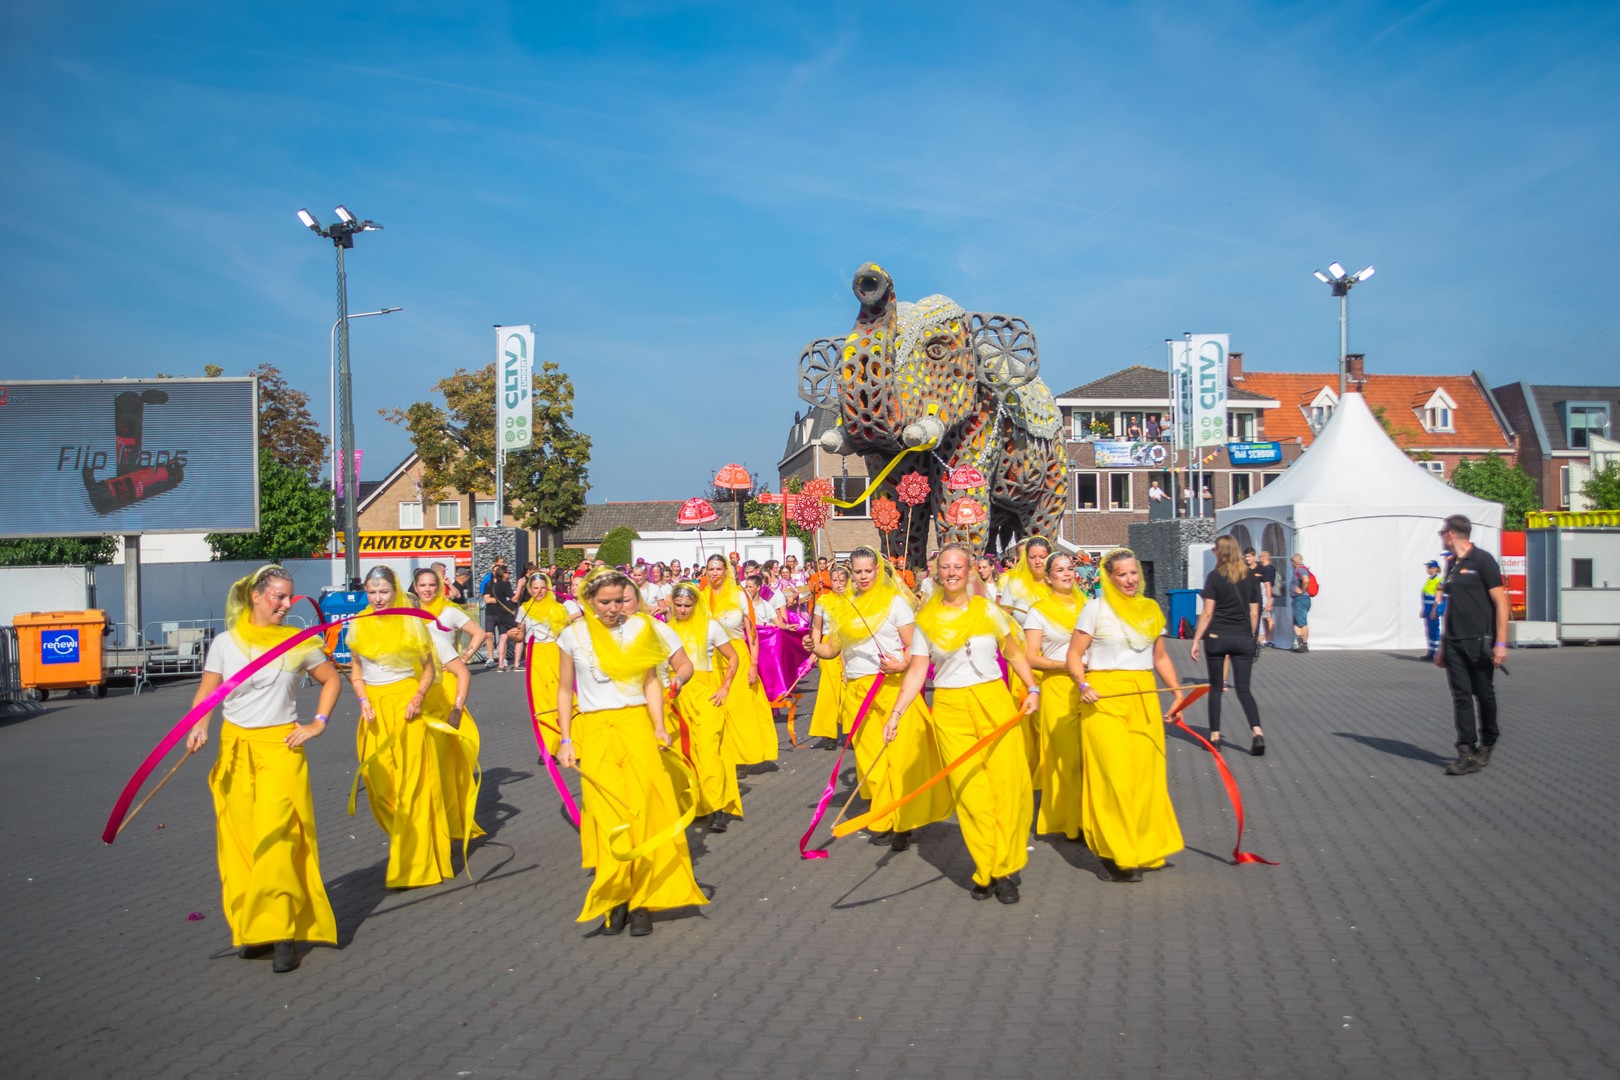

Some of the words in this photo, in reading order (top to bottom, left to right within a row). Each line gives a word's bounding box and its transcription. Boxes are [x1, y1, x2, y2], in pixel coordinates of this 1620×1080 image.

[505, 351, 518, 409] CLTV
[1199, 355, 1216, 410] CLTV
[57, 445, 108, 472] Flip
